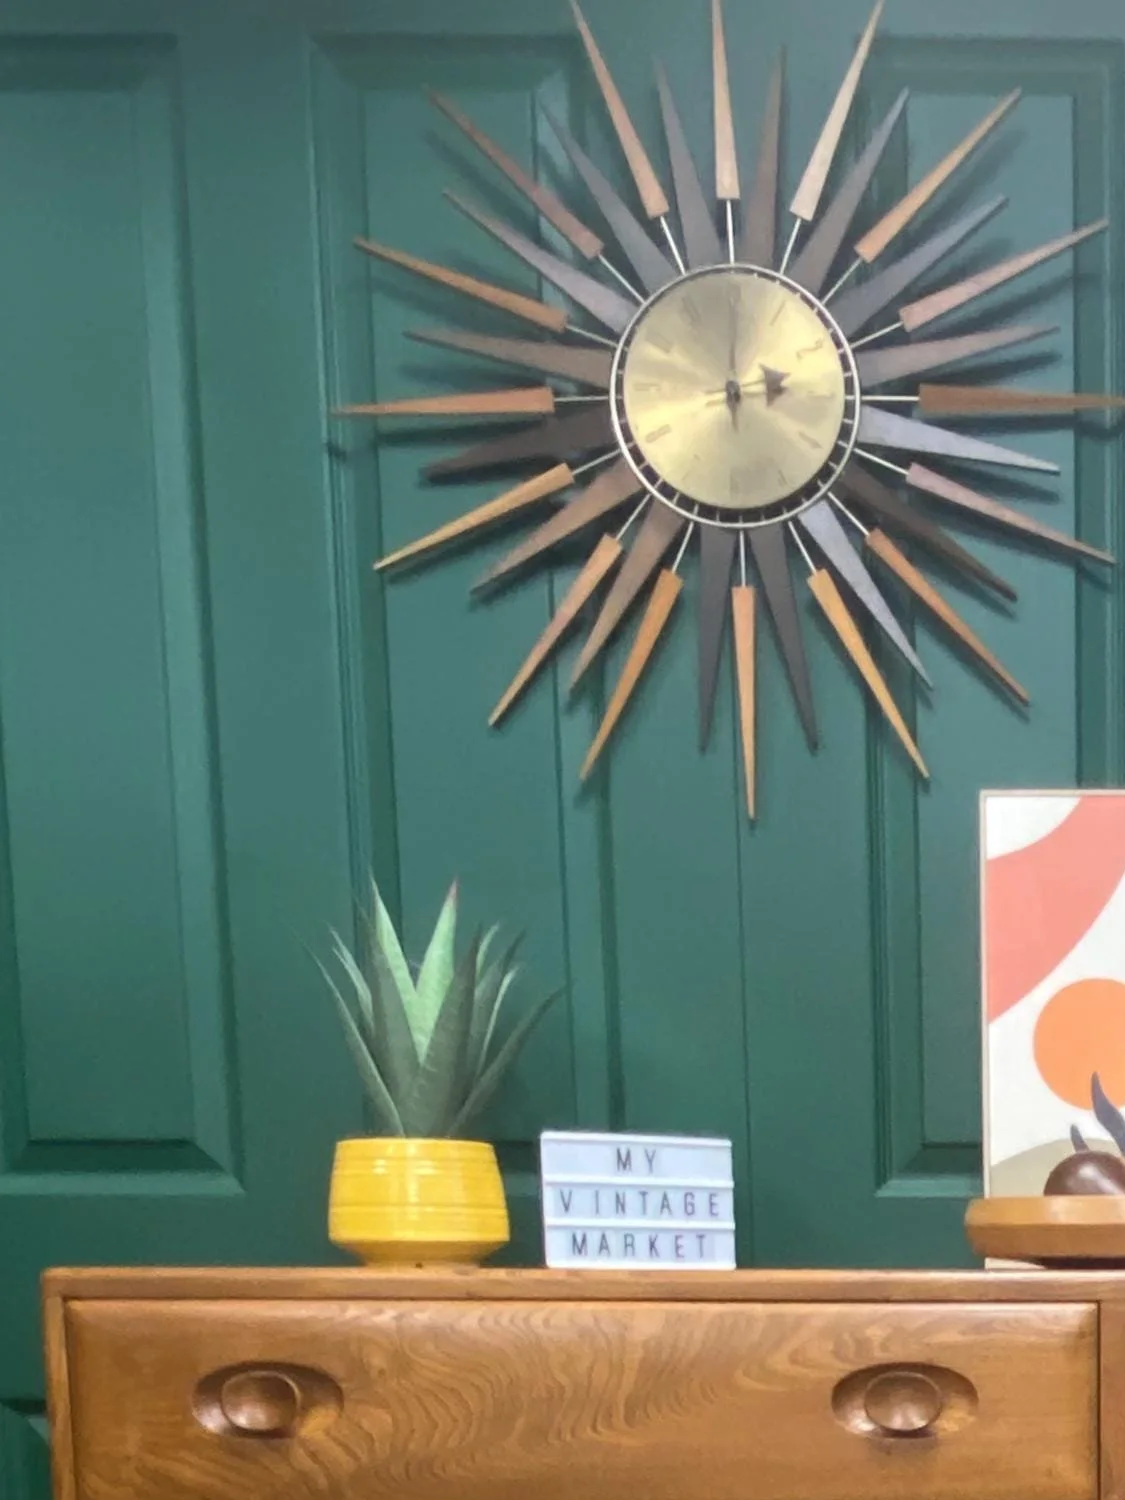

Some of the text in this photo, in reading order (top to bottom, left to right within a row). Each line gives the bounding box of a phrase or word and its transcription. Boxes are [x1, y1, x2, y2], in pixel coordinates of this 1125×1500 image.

[616, 1147, 656, 1173] MY
[559, 1188, 720, 1217] VINTAGE
[571, 1232, 706, 1259] MARKET
